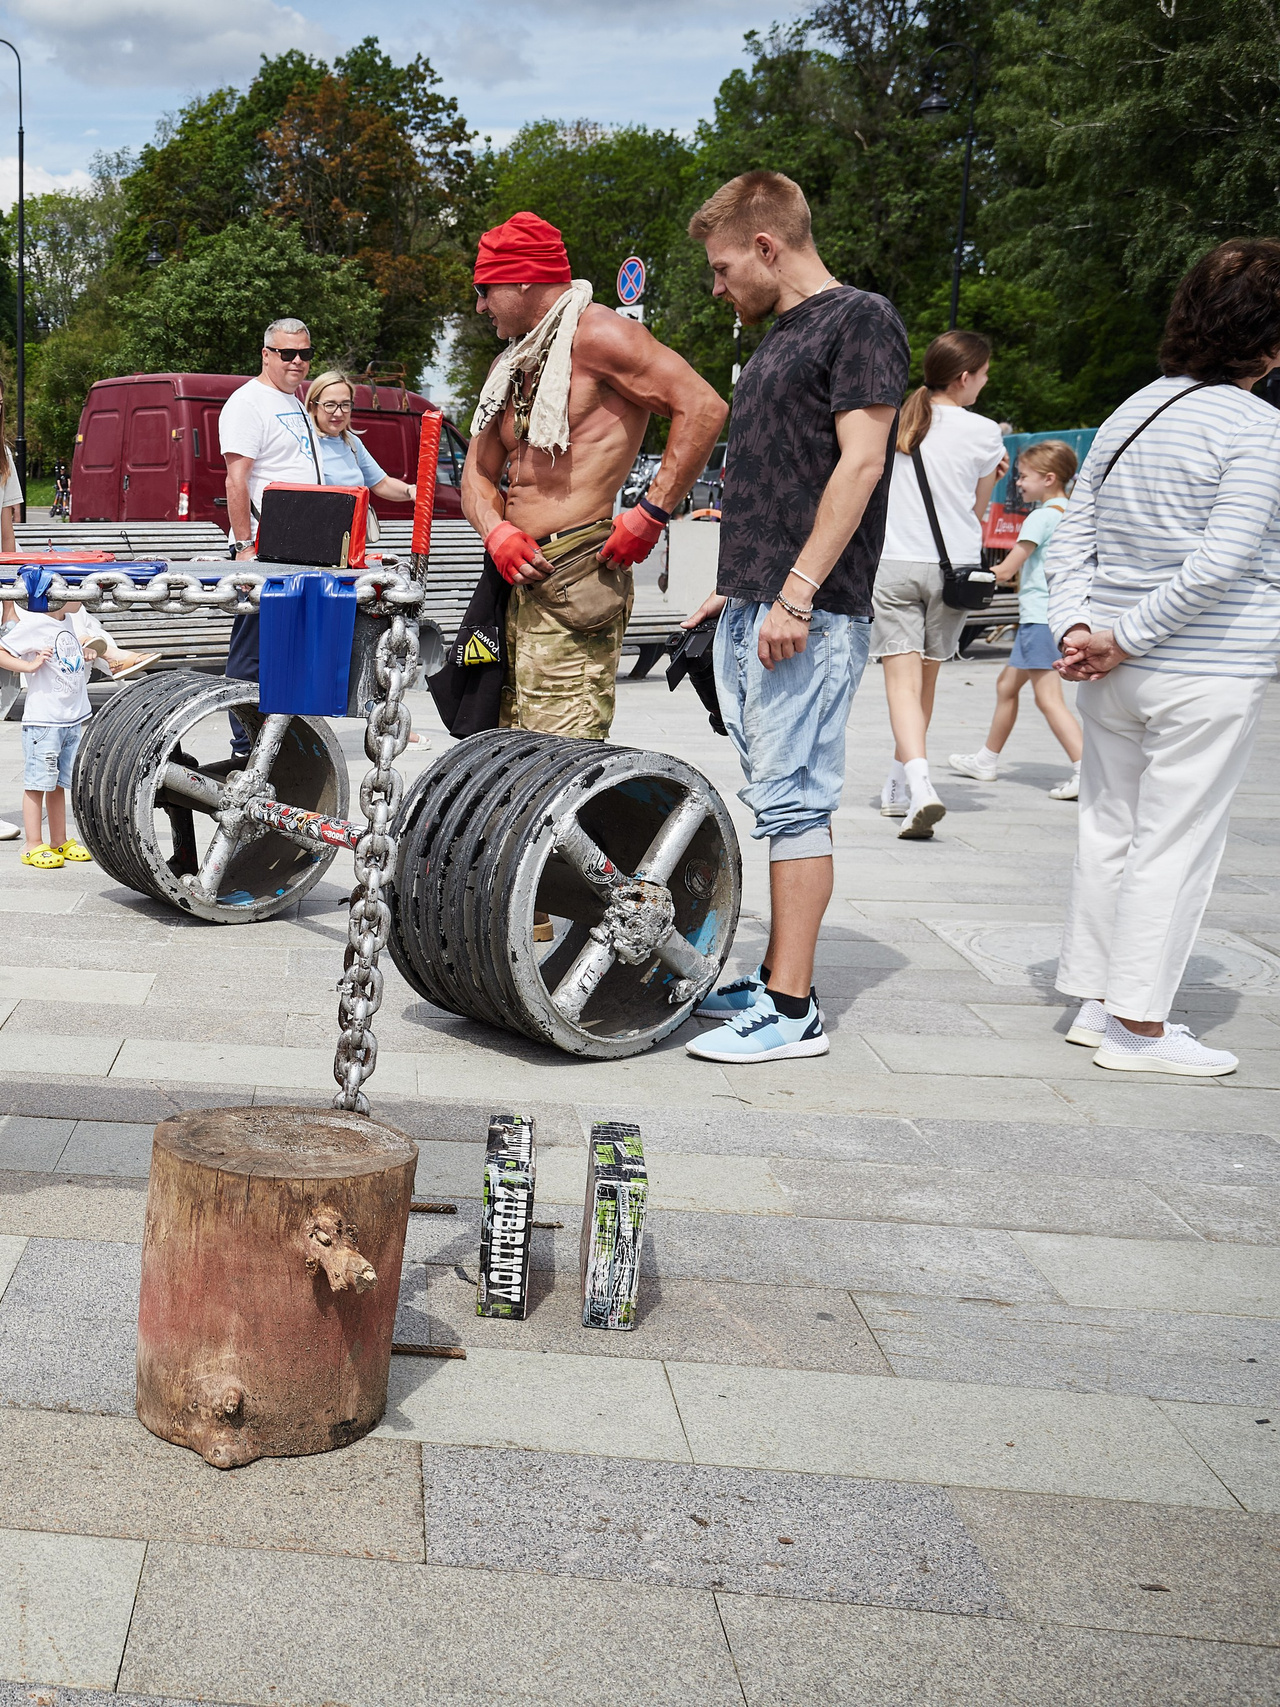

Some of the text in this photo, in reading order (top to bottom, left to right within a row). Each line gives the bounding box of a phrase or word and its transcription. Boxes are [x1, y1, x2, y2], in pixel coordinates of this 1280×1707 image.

[994, 518, 1015, 534] День
[473, 630, 500, 653] Power
[488, 1185, 529, 1302] ZUBRINOV
